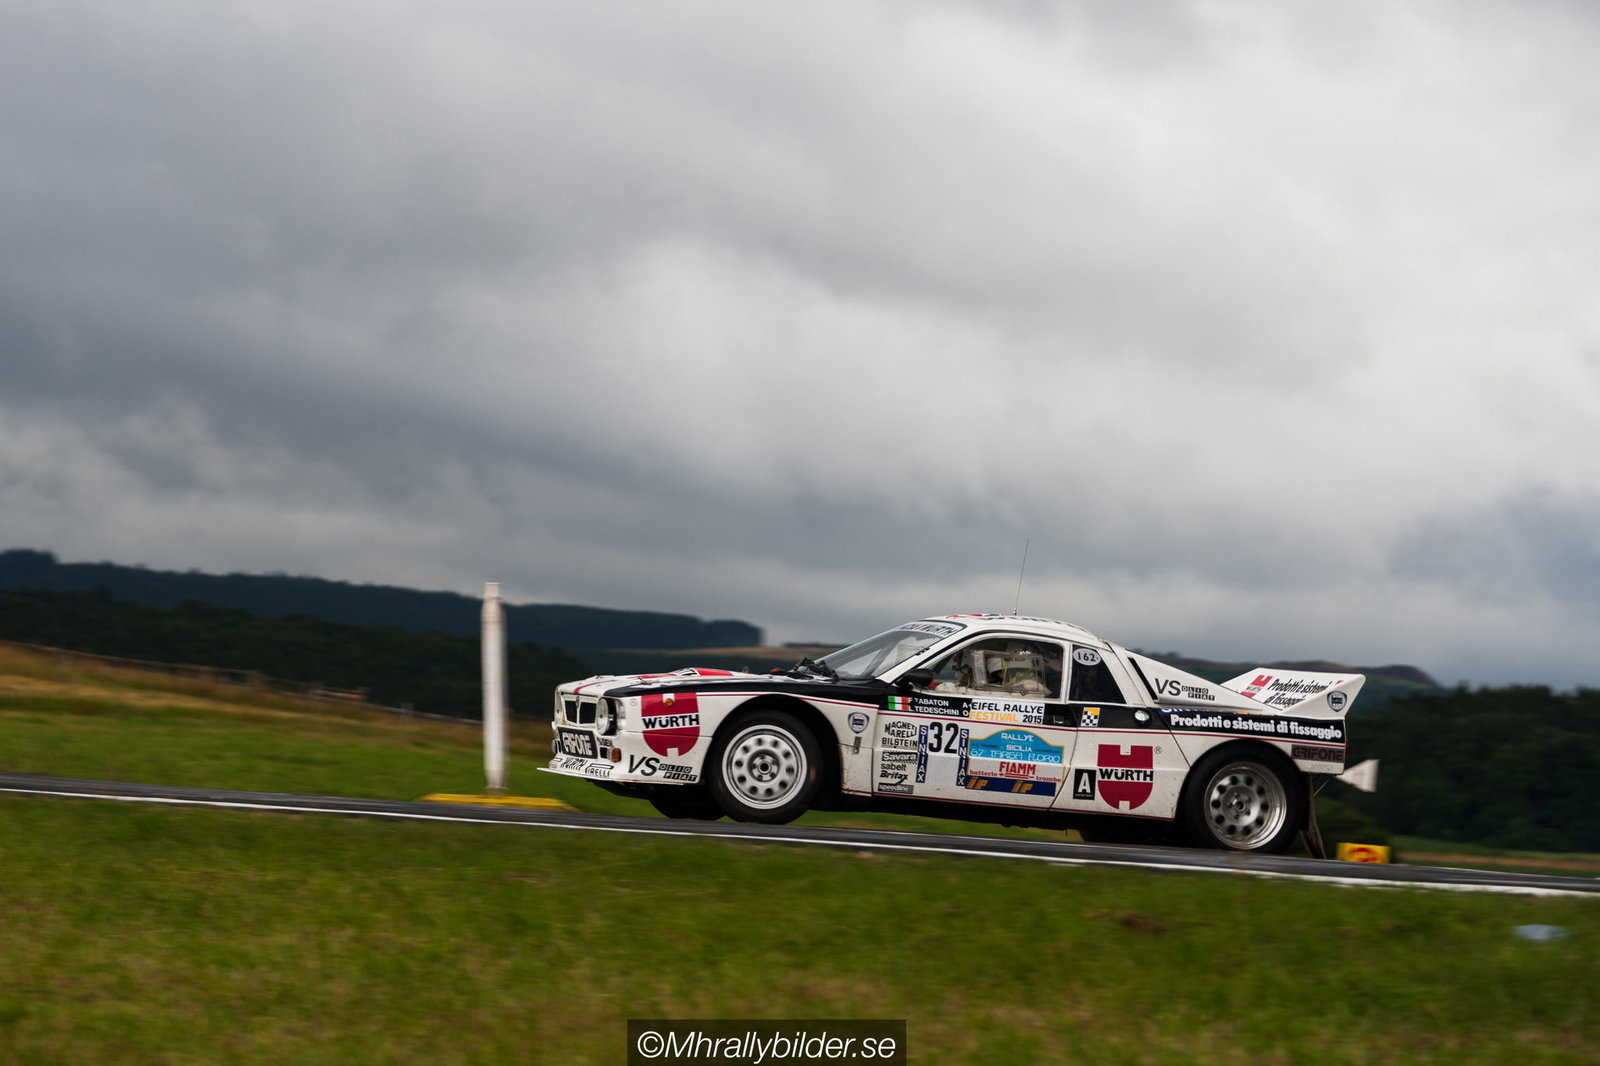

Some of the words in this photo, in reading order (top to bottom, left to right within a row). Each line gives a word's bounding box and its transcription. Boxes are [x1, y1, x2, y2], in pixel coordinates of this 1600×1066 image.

[1077, 652, 1096, 662] 162
[1155, 678, 1181, 696] VS
[1182, 686, 1208, 695] OLIO
[1268, 678, 1303, 692] Prodotti
[914, 697, 949, 707] TABATON
[1188, 693, 1215, 701] FIAT
[914, 706, 960, 716] TEDESCHINI
[971, 702, 1001, 711] EIFEL
[1003, 703, 1043, 714] RALLYE
[642, 714, 699, 729] WÜRTH
[969, 711, 1019, 722] FESTIVAL
[1022, 714, 1042, 724] 2015
[1170, 714, 1222, 728] Prodotti
[1223, 719, 1232, 729] e
[1232, 717, 1275, 733] sistemi
[1276, 720, 1288, 734] di
[1289, 722, 1342, 740] fissaggio
[881, 737, 918, 747] BILSTEIN
[929, 722, 959, 754] 32
[1001, 733, 1034, 742] RALLYE
[1293, 744, 1344, 761] GRIFONE
[628, 754, 660, 777] VS
[659, 764, 693, 773] OLIO
[999, 761, 1036, 775] FIAMM
[663, 772, 698, 782] FIAT
[880, 770, 908, 780] Britax
[1099, 768, 1153, 781] WÜRTH
[1078, 772, 1091, 793] A
